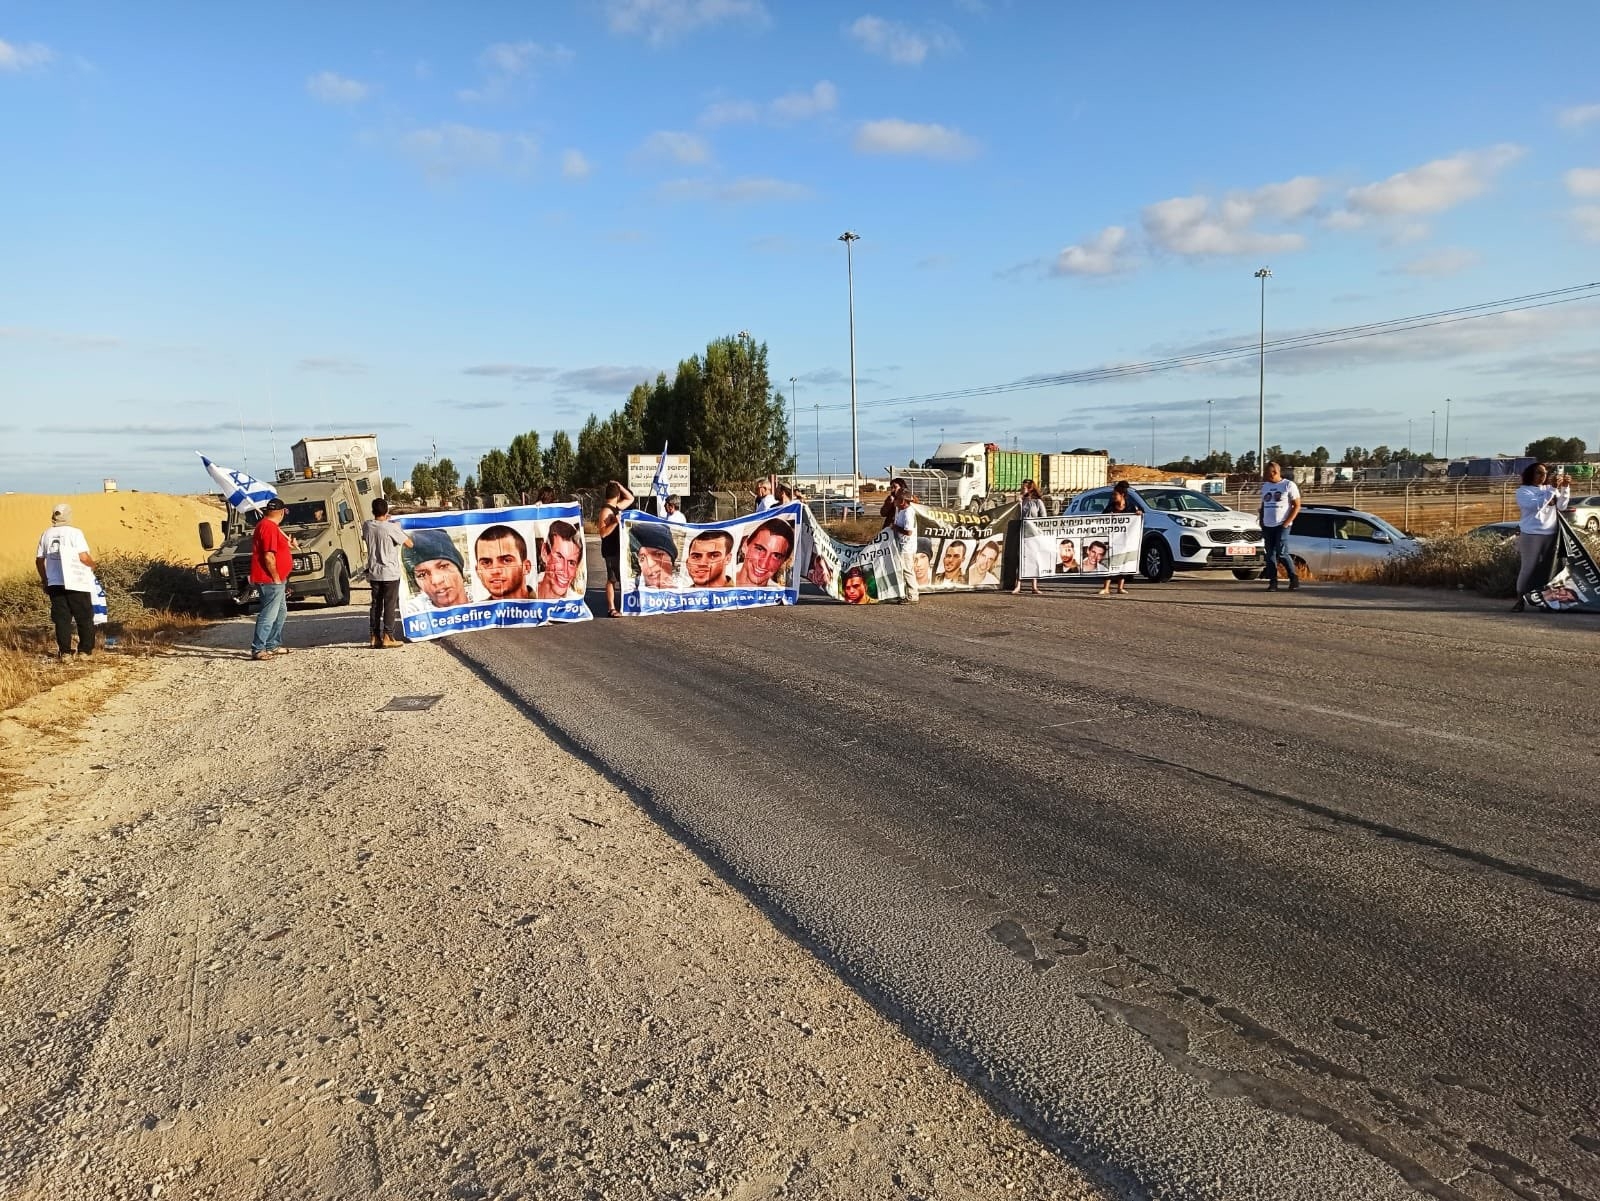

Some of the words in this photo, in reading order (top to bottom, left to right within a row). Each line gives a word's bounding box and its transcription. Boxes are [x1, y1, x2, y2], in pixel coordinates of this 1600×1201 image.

[1085, 516, 1130, 526] כשמפחדים
[924, 527, 951, 537] אברה
[1077, 526, 1091, 535] את
[1090, 525, 1127, 534] מפקירים
[649, 594, 677, 610] boys
[680, 594, 708, 606] have
[409, 619, 426, 633] No
[430, 608, 491, 628] ceasefire
[495, 606, 543, 620] without
